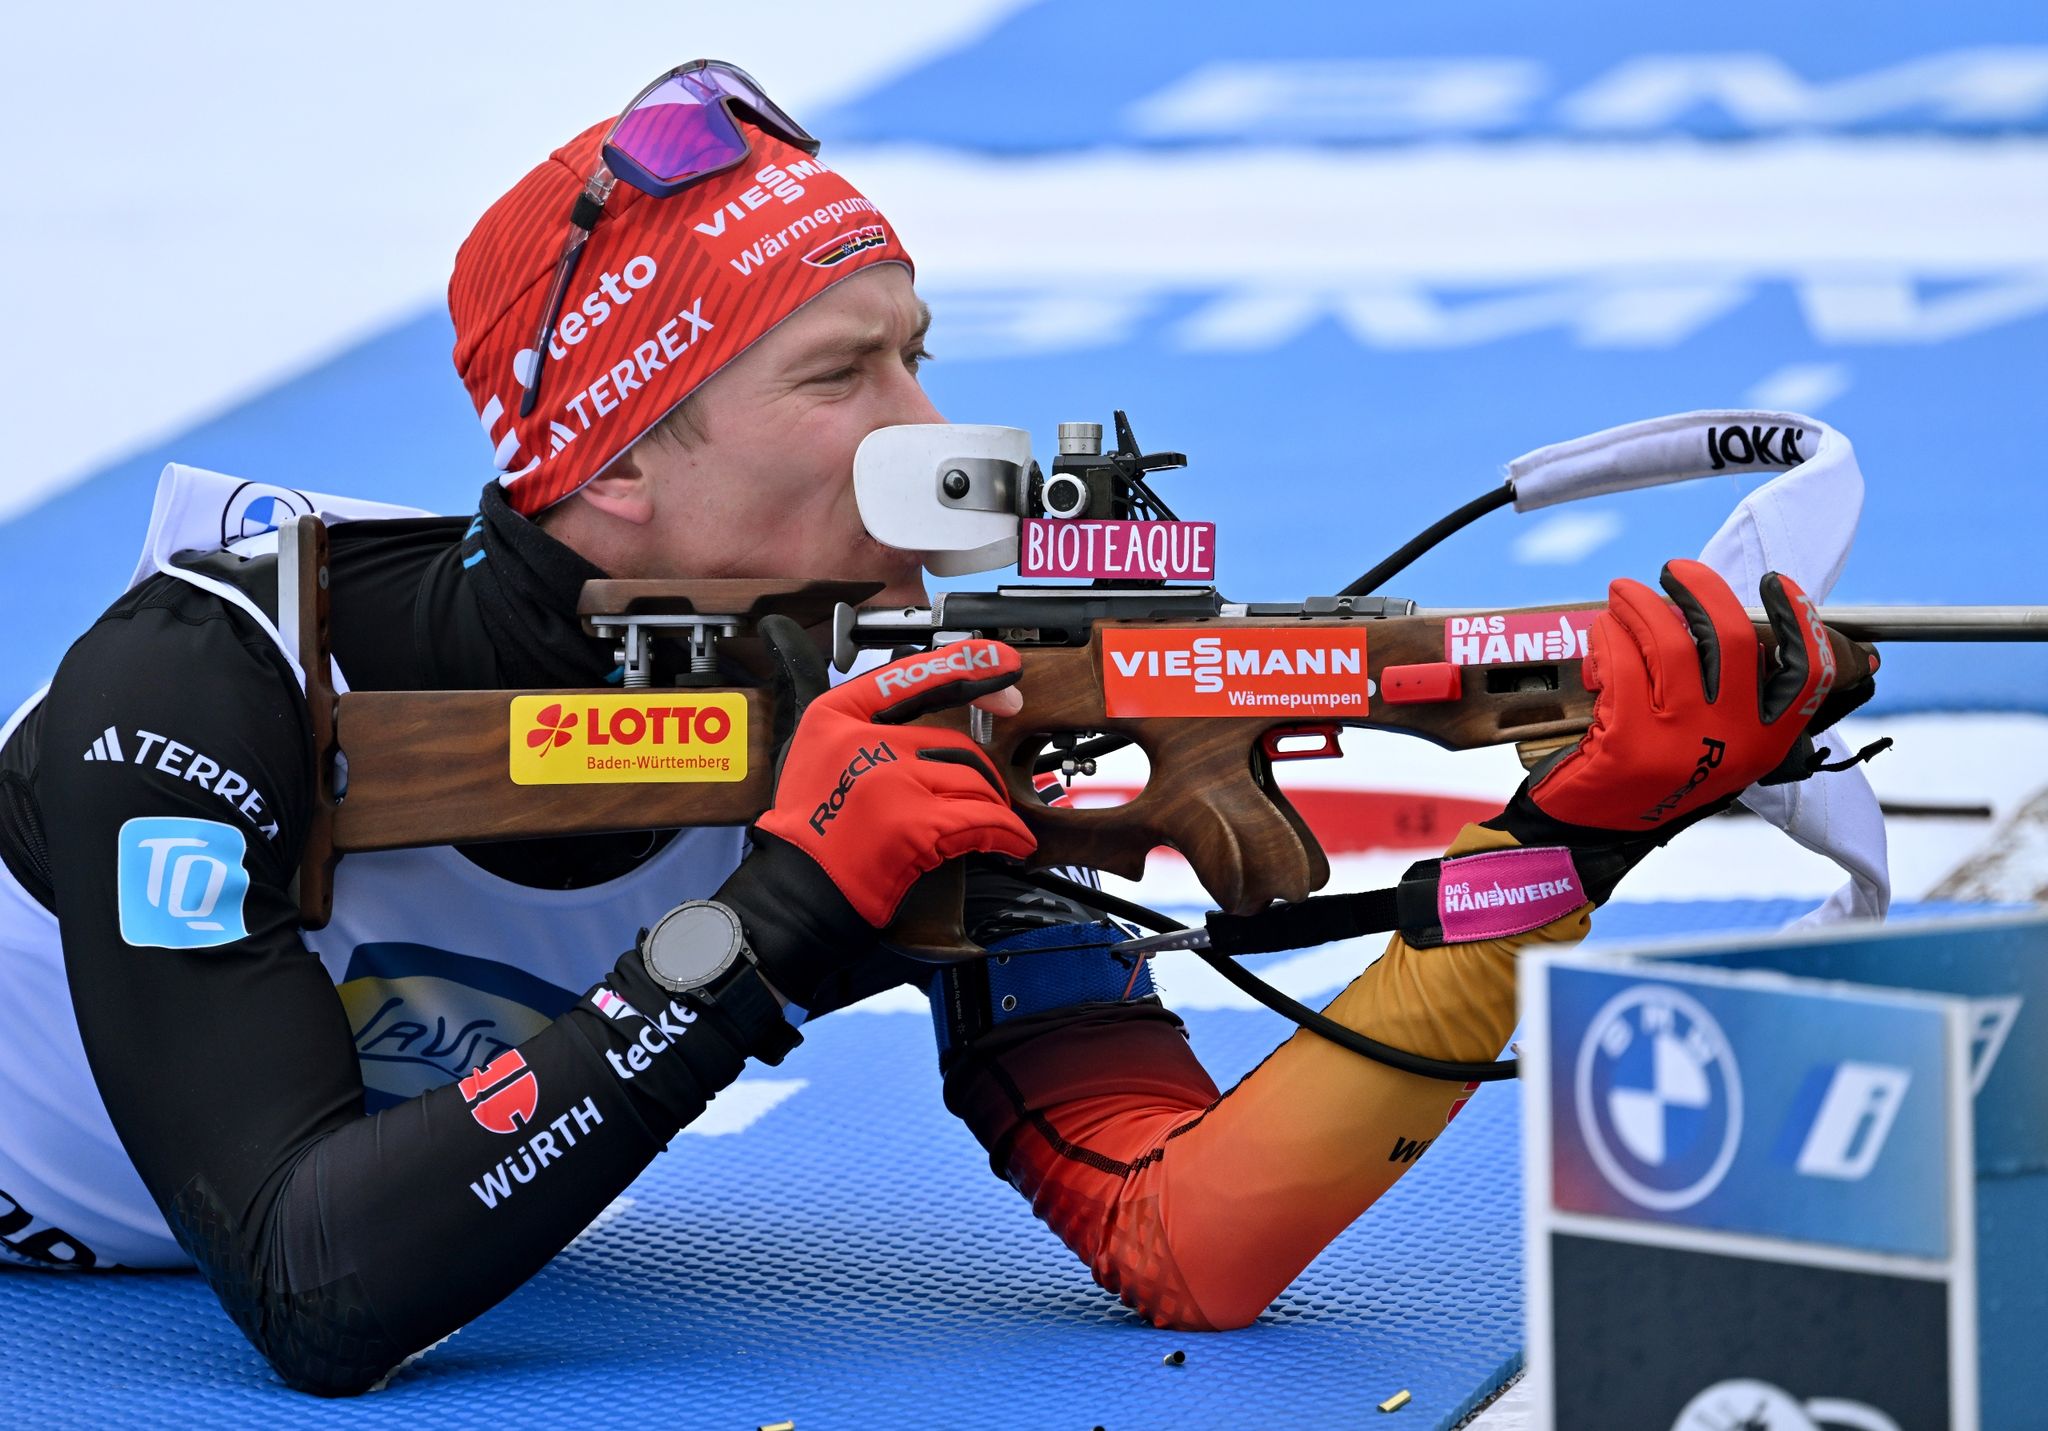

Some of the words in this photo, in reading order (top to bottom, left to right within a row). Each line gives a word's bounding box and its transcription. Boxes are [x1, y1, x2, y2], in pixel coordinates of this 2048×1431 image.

[547, 255, 657, 361] testo
[565, 297, 715, 430] TERREX
[1028, 521, 1210, 577] BIOTEAQUE
[1451, 615, 1506, 636] DAS
[1110, 637, 1360, 693] VIESSMANN
[587, 706, 731, 746] LOTTO
[1228, 690, 1362, 708] Wärmepumpen
[587, 755, 730, 771] Baden-Württemberg
[138, 838, 228, 931] TQ
[1445, 882, 1470, 896] DAS
[469, 1096, 604, 1210] WÜRTH
